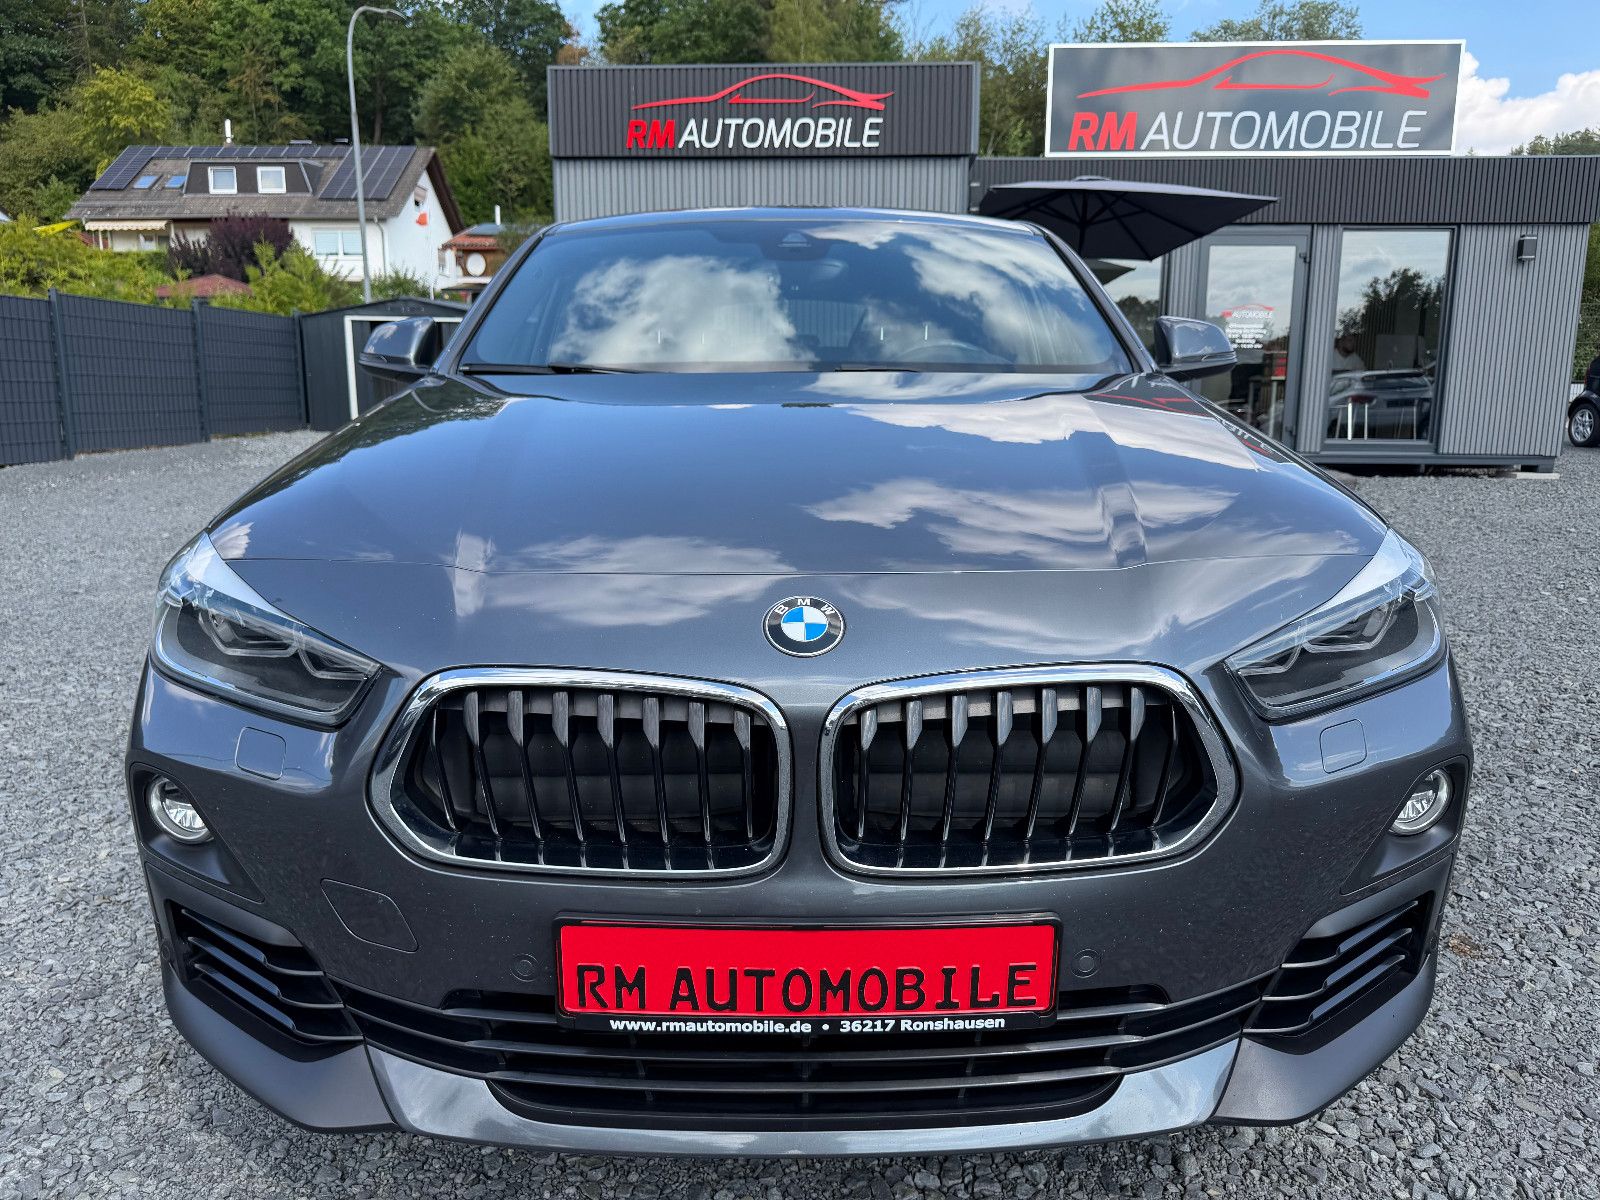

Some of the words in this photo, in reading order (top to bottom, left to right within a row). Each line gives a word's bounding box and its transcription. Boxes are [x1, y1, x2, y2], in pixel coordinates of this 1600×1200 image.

[626, 119, 676, 150] RM
[678, 117, 884, 149] AUTOMOBILE
[1068, 112, 1137, 151] RM
[1140, 110, 1428, 150] AUTOMOBILE
[774, 598, 836, 615] BMW
[577, 963, 646, 1010] RM
[669, 962, 1037, 1012] AUTOMOBILE
[609, 1019, 812, 1034] www.rmautomobile.de
[840, 1019, 896, 1033] 36217
[900, 1017, 1006, 1031] Ronshausen
